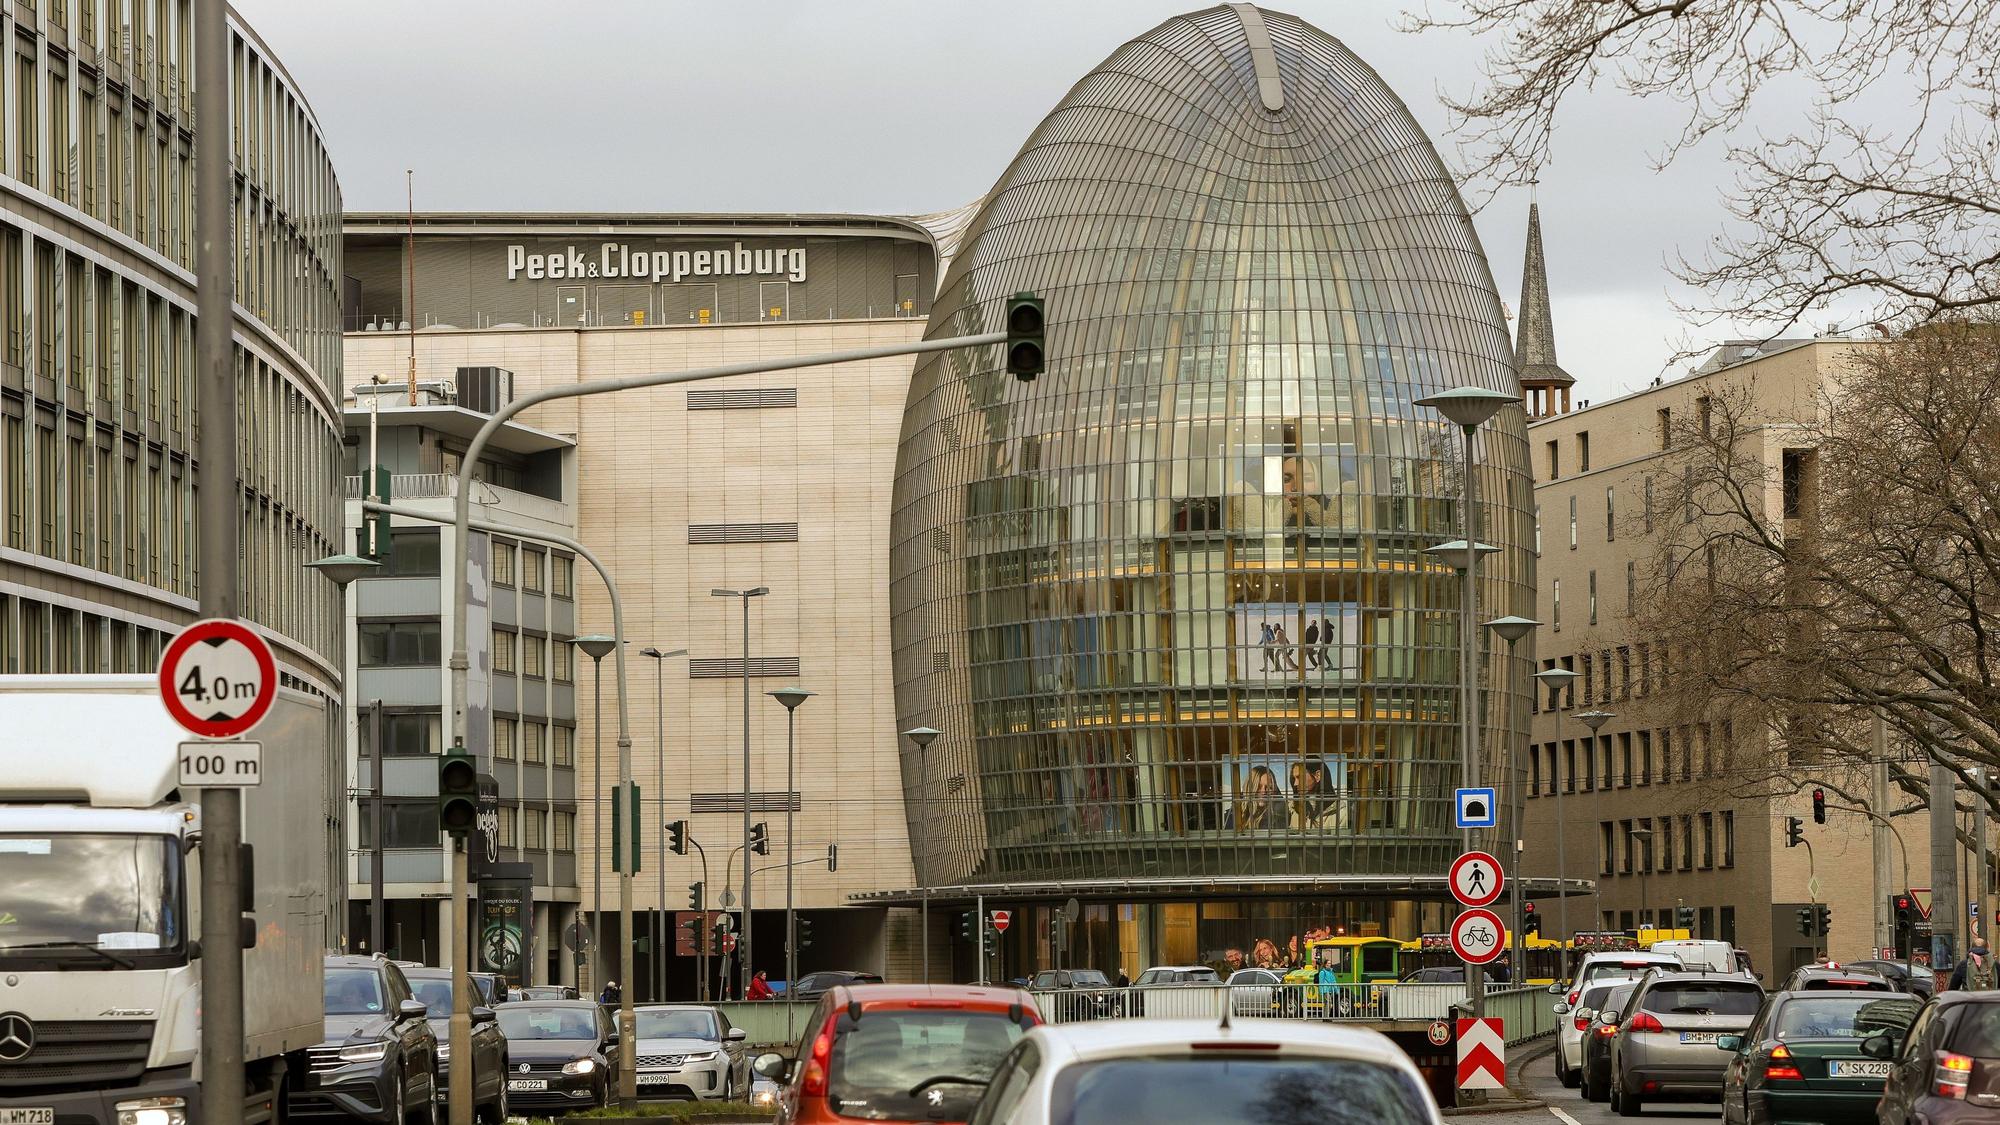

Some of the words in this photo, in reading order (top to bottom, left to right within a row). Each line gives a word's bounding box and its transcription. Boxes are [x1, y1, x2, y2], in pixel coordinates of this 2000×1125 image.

[181, 755, 225, 775] 100
[235, 759, 257, 774] m
[1685, 1033, 1697, 1041] BM
[1702, 1033, 1714, 1041] MP
[1837, 1063, 1845, 1074] K
[1851, 1063, 1866, 1074] SK
[516, 1081, 528, 1089] CO
[10, 1110, 27, 1123] WM
[29, 1110, 52, 1123] 718
